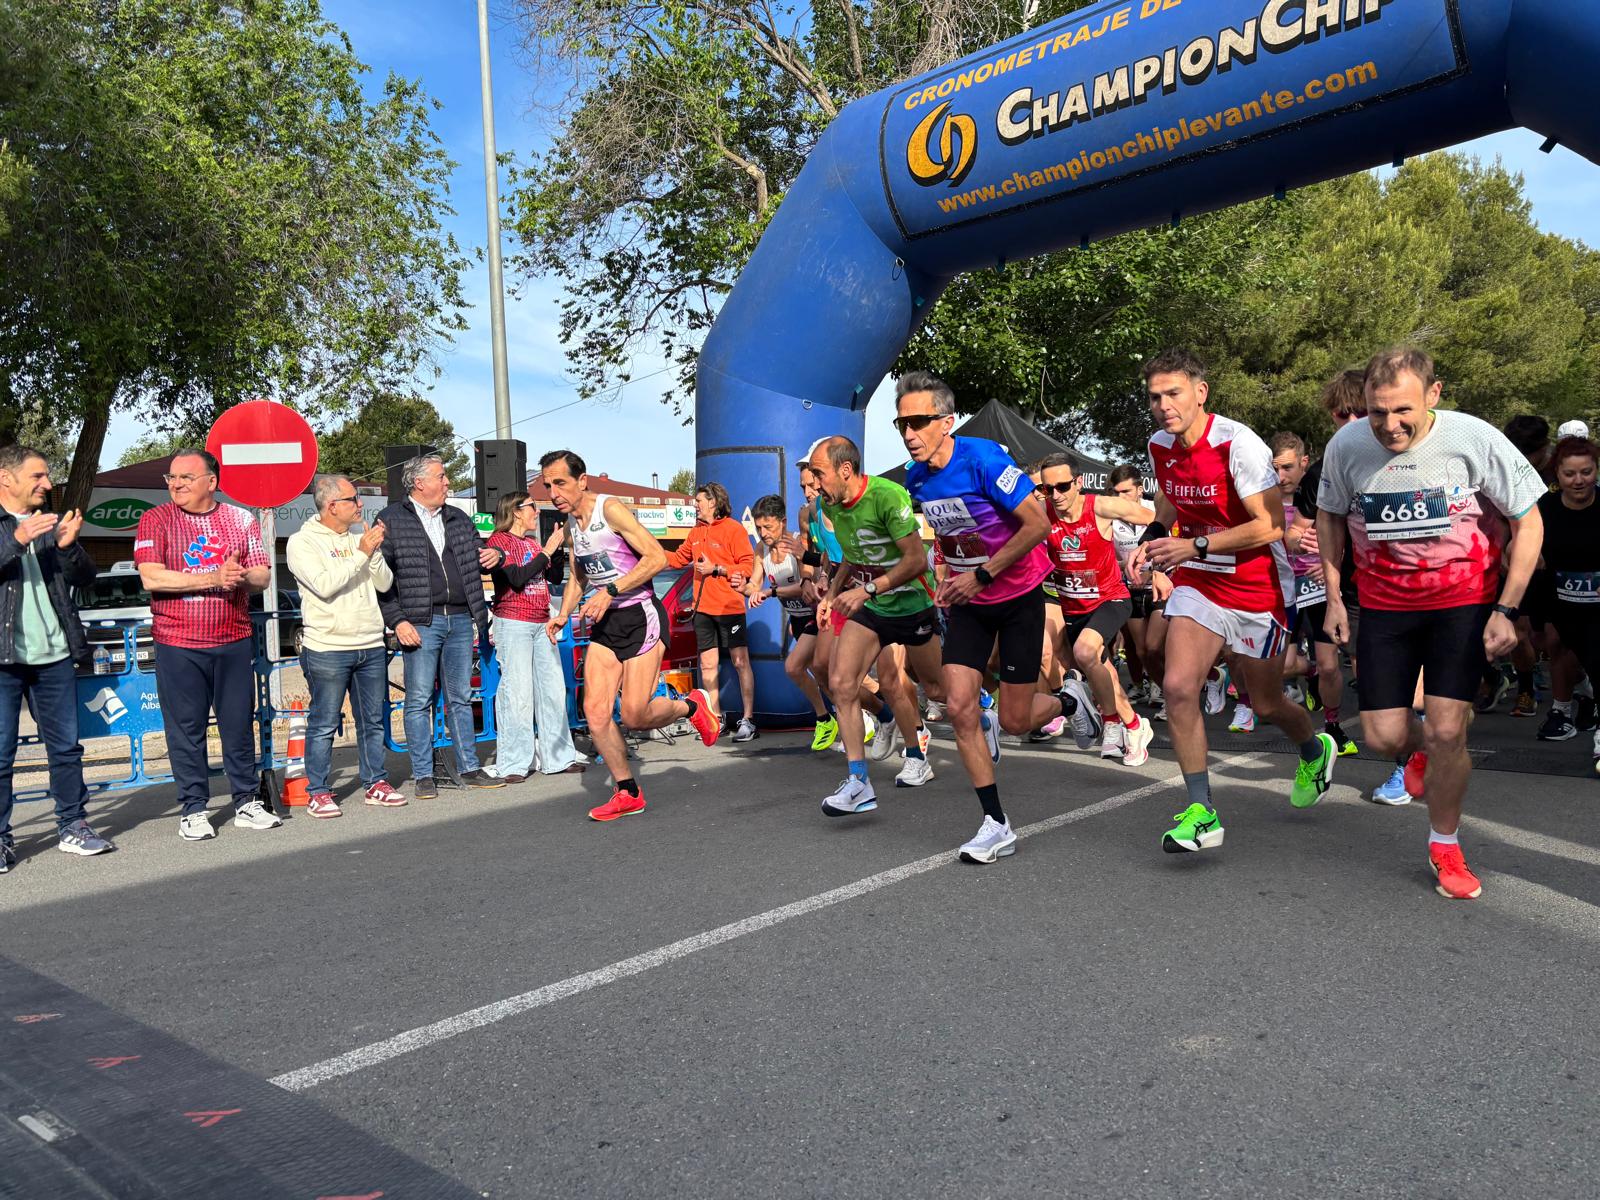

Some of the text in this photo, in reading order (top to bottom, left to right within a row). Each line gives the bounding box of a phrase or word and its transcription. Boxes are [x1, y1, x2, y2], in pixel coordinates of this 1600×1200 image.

[904, 7, 1131, 110] CRONOMETRAJE
[937, 60, 1378, 214] www.championchiplevante.com
[1174, 484, 1218, 496] EIFFAGE
[92, 505, 145, 519] ardo
[925, 503, 962, 517] AQUA
[1381, 502, 1429, 522] 668
[929, 515, 966, 528] DEUS
[956, 545, 965, 558] 4
[585, 561, 606, 574] 654
[1065, 577, 1083, 588] 52
[1564, 578, 1592, 590] 671
[141, 692, 159, 701] Agu
[141, 702, 161, 710] Alba
